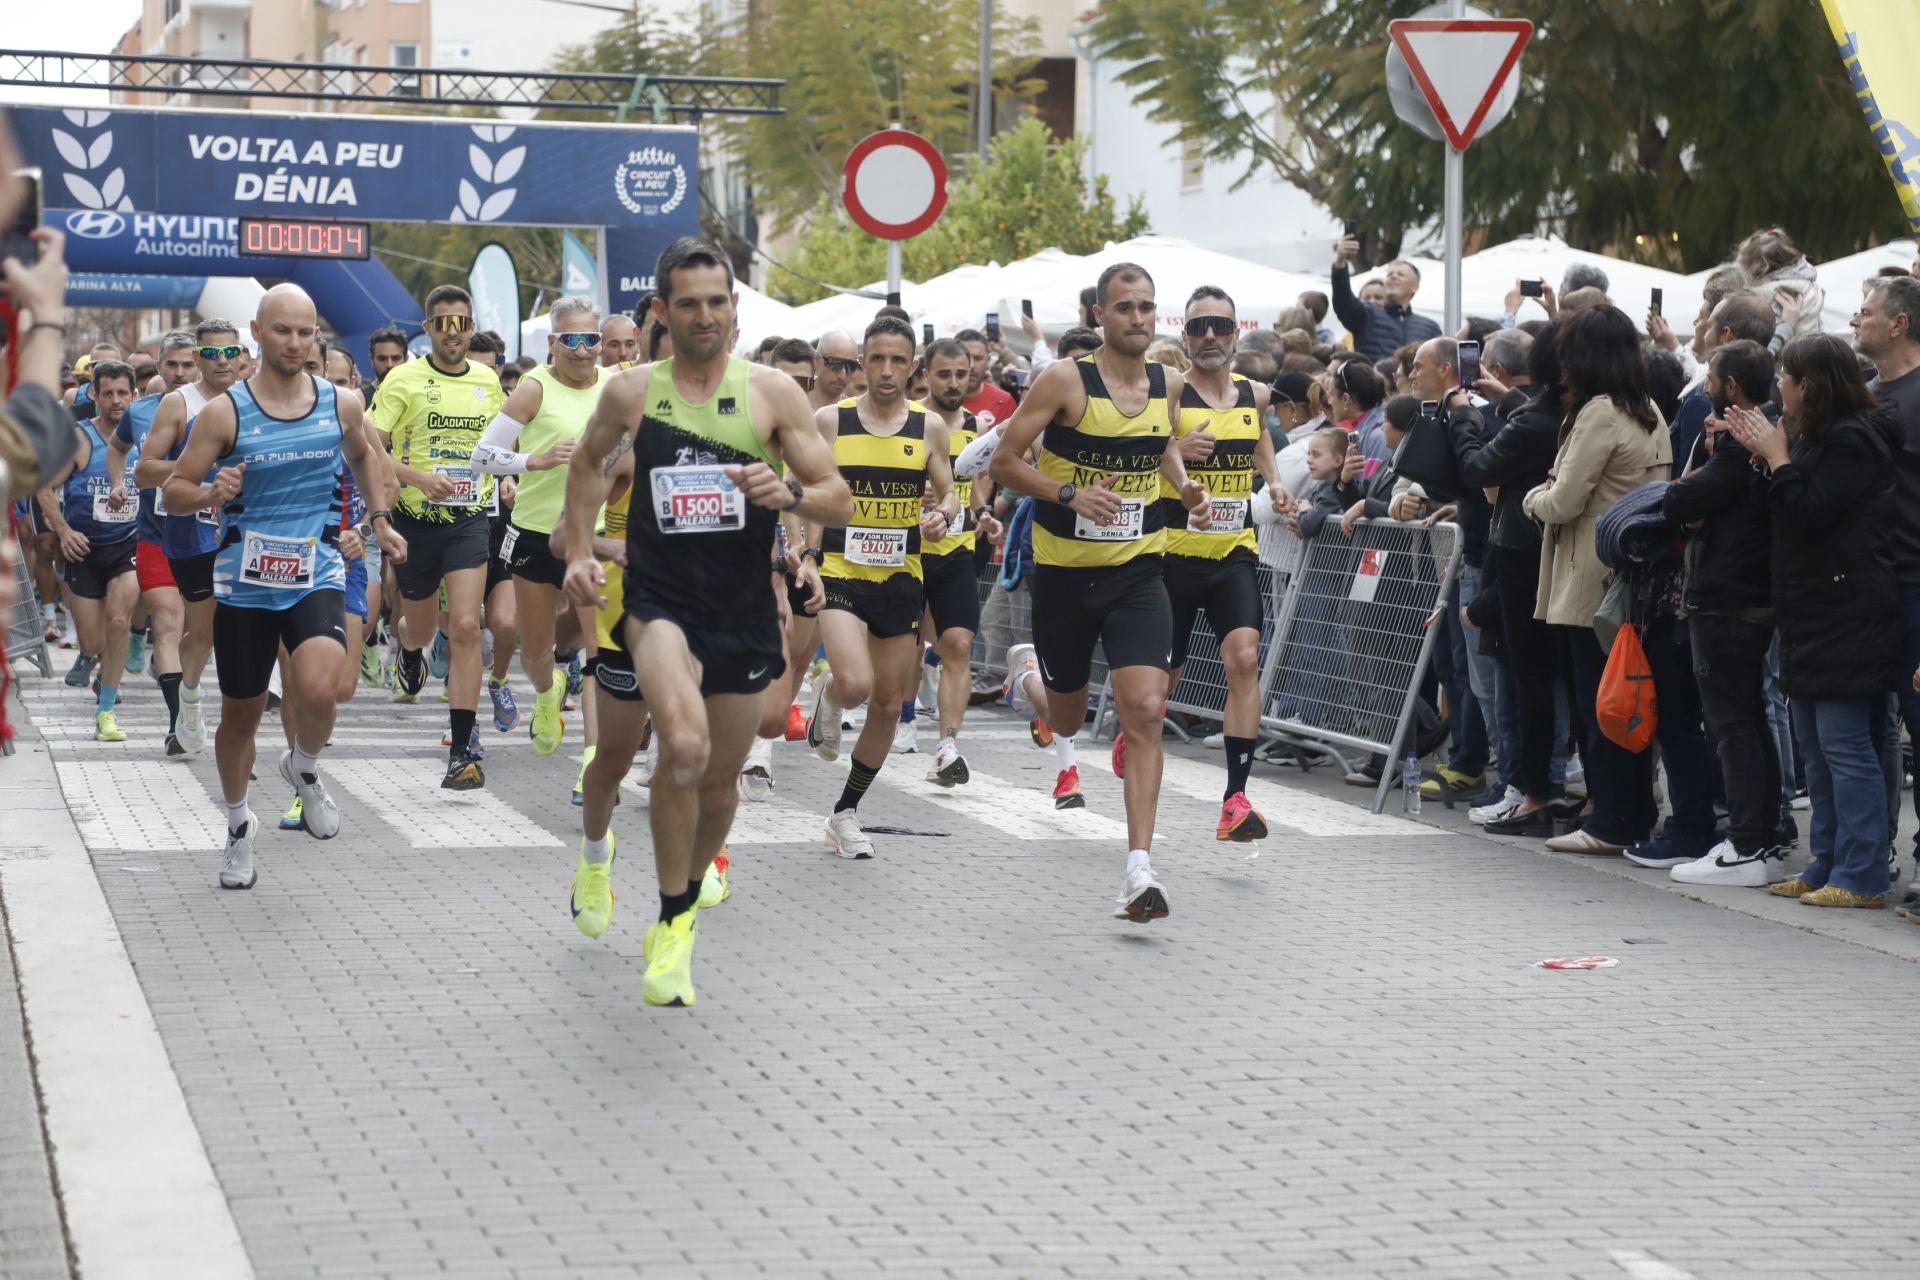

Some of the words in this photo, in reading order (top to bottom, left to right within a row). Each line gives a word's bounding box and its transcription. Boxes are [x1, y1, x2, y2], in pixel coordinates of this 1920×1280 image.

[188, 134, 298, 164] VOLTA
[301, 140, 329, 165] A
[334, 141, 403, 168] PEU
[629, 170, 672, 180] CIRCUIT
[234, 166, 358, 206] DÉNIA
[634, 180, 644, 189] A
[644, 180, 667, 189] PEU
[110, 281, 143, 293] ALTA
[429, 413, 485, 431] GLADIATORS
[662, 501, 671, 515] B
[675, 497, 720, 516] 1500
[862, 541, 893, 554] 3707
[249, 558, 258, 569] A
[263, 558, 298, 575] 1497
